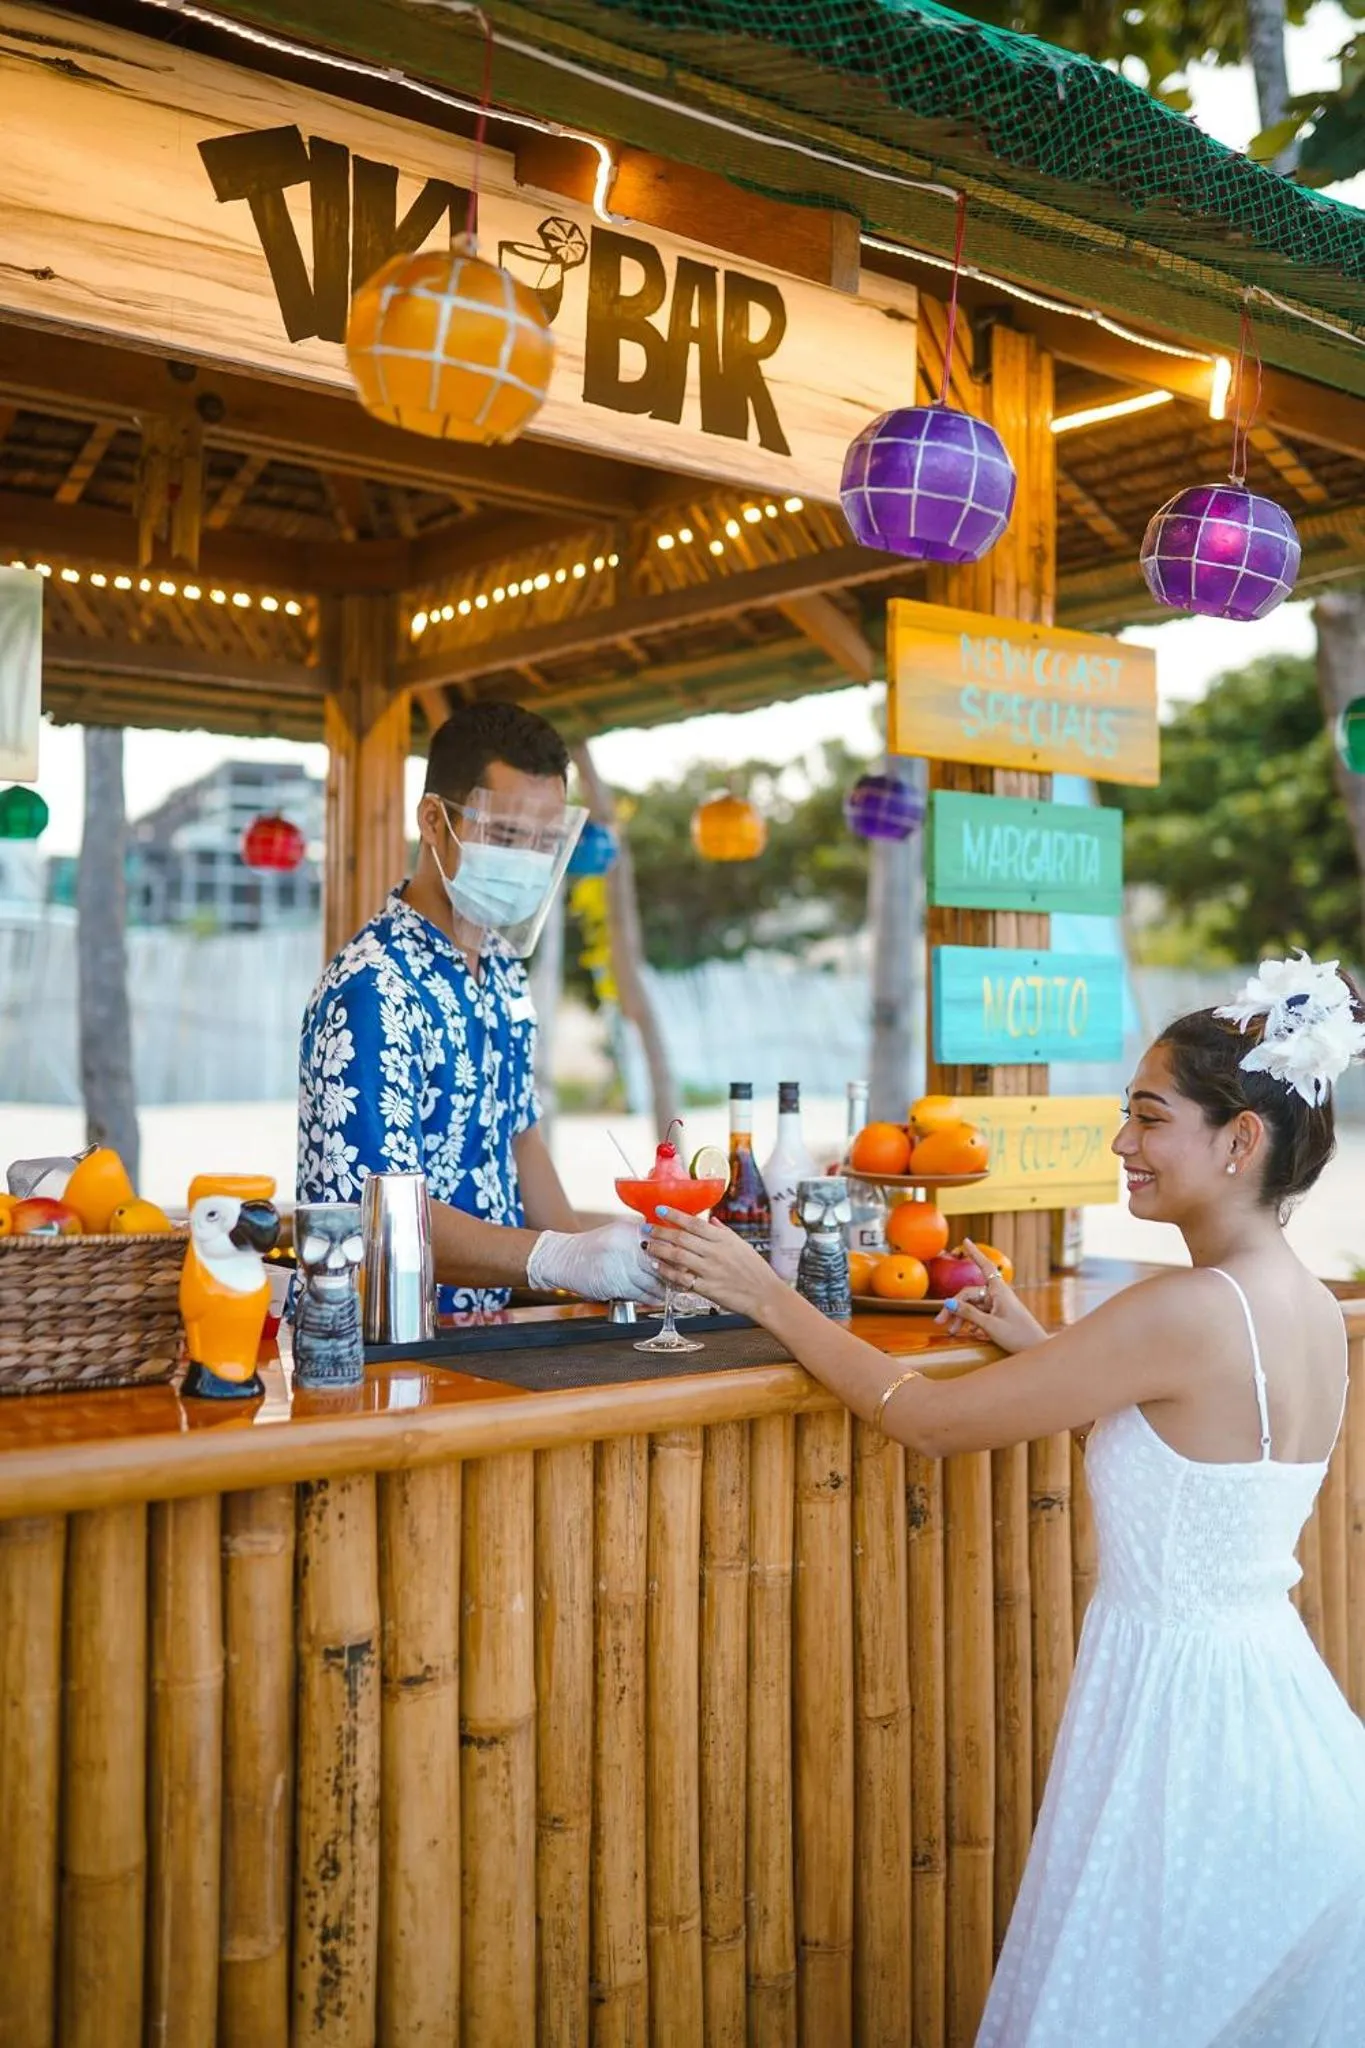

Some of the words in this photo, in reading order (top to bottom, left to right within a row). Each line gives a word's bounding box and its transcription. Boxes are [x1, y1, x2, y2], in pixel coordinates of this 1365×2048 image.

[582, 224, 792, 457] BAR
[960, 685, 1120, 759] SPECIALS
[962, 819, 1100, 885] MARGARITA
[983, 975, 1089, 1039] MOJITO
